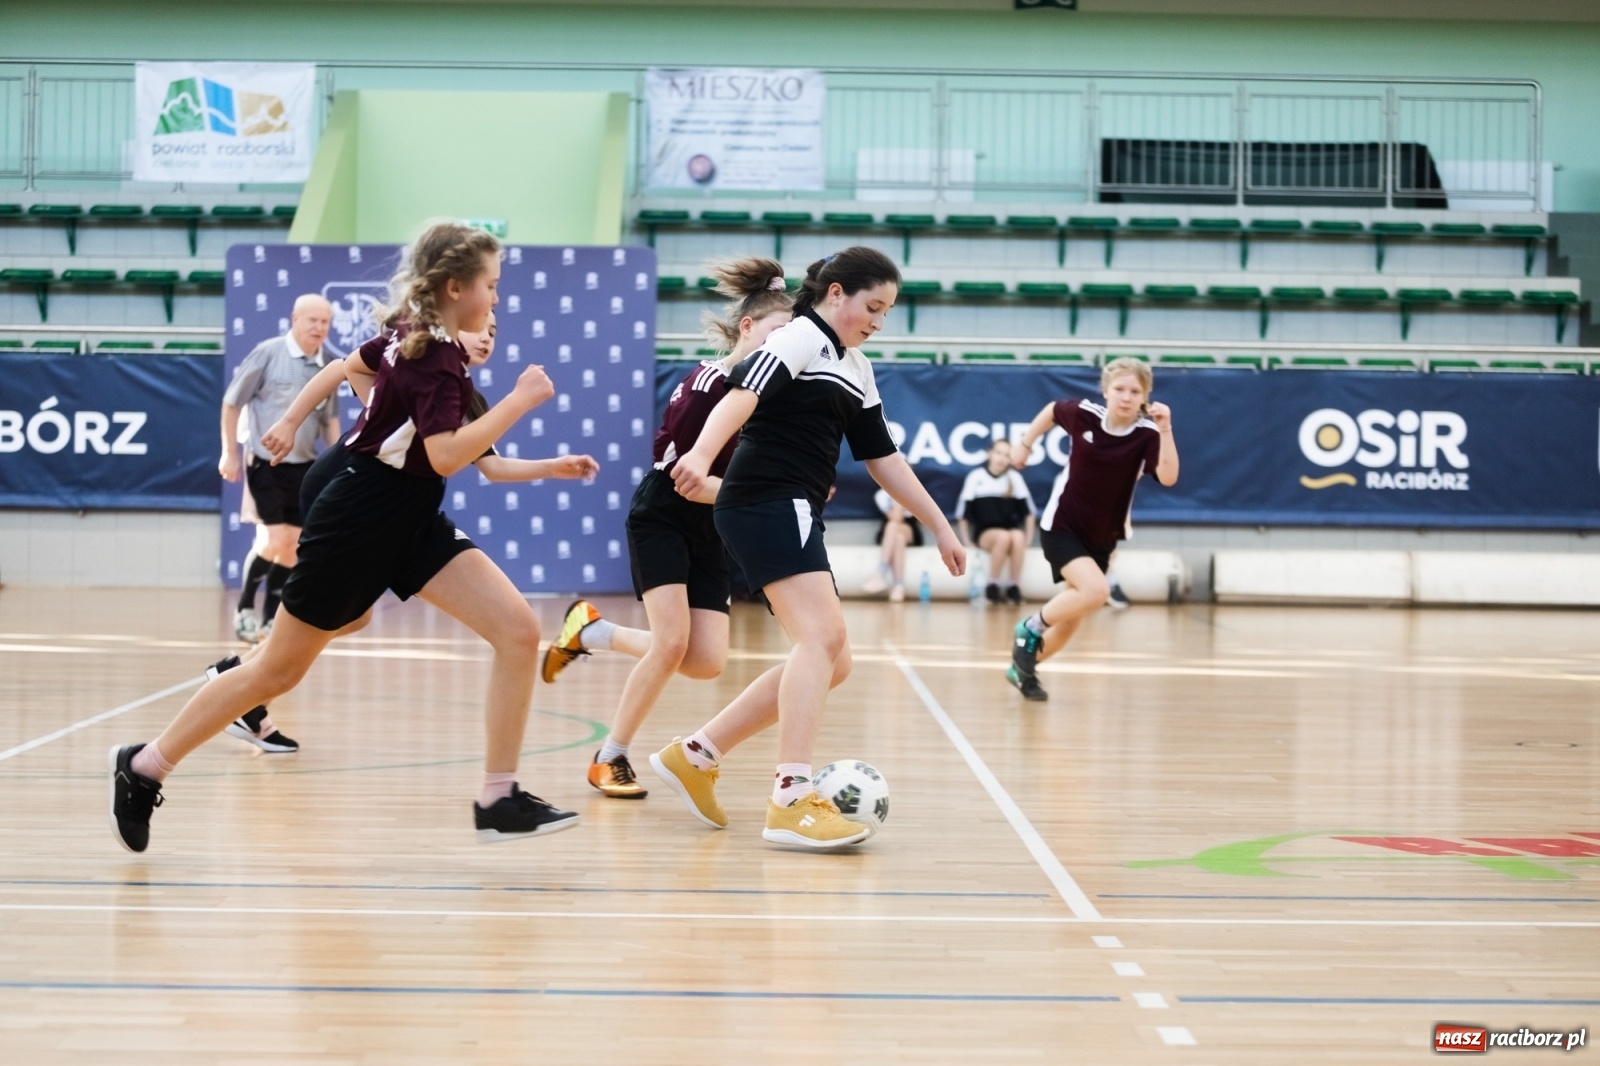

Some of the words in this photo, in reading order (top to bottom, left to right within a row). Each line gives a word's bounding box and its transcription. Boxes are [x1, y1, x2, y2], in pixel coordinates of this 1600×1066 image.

[669, 75, 804, 102] MIESZKO
[152, 140, 207, 156] powiat
[217, 139, 296, 156] raciborski
[0, 395, 148, 455] BÓRZ
[1298, 408, 1470, 469] OSiR
[1366, 468, 1469, 490] RACIBÓRZ
